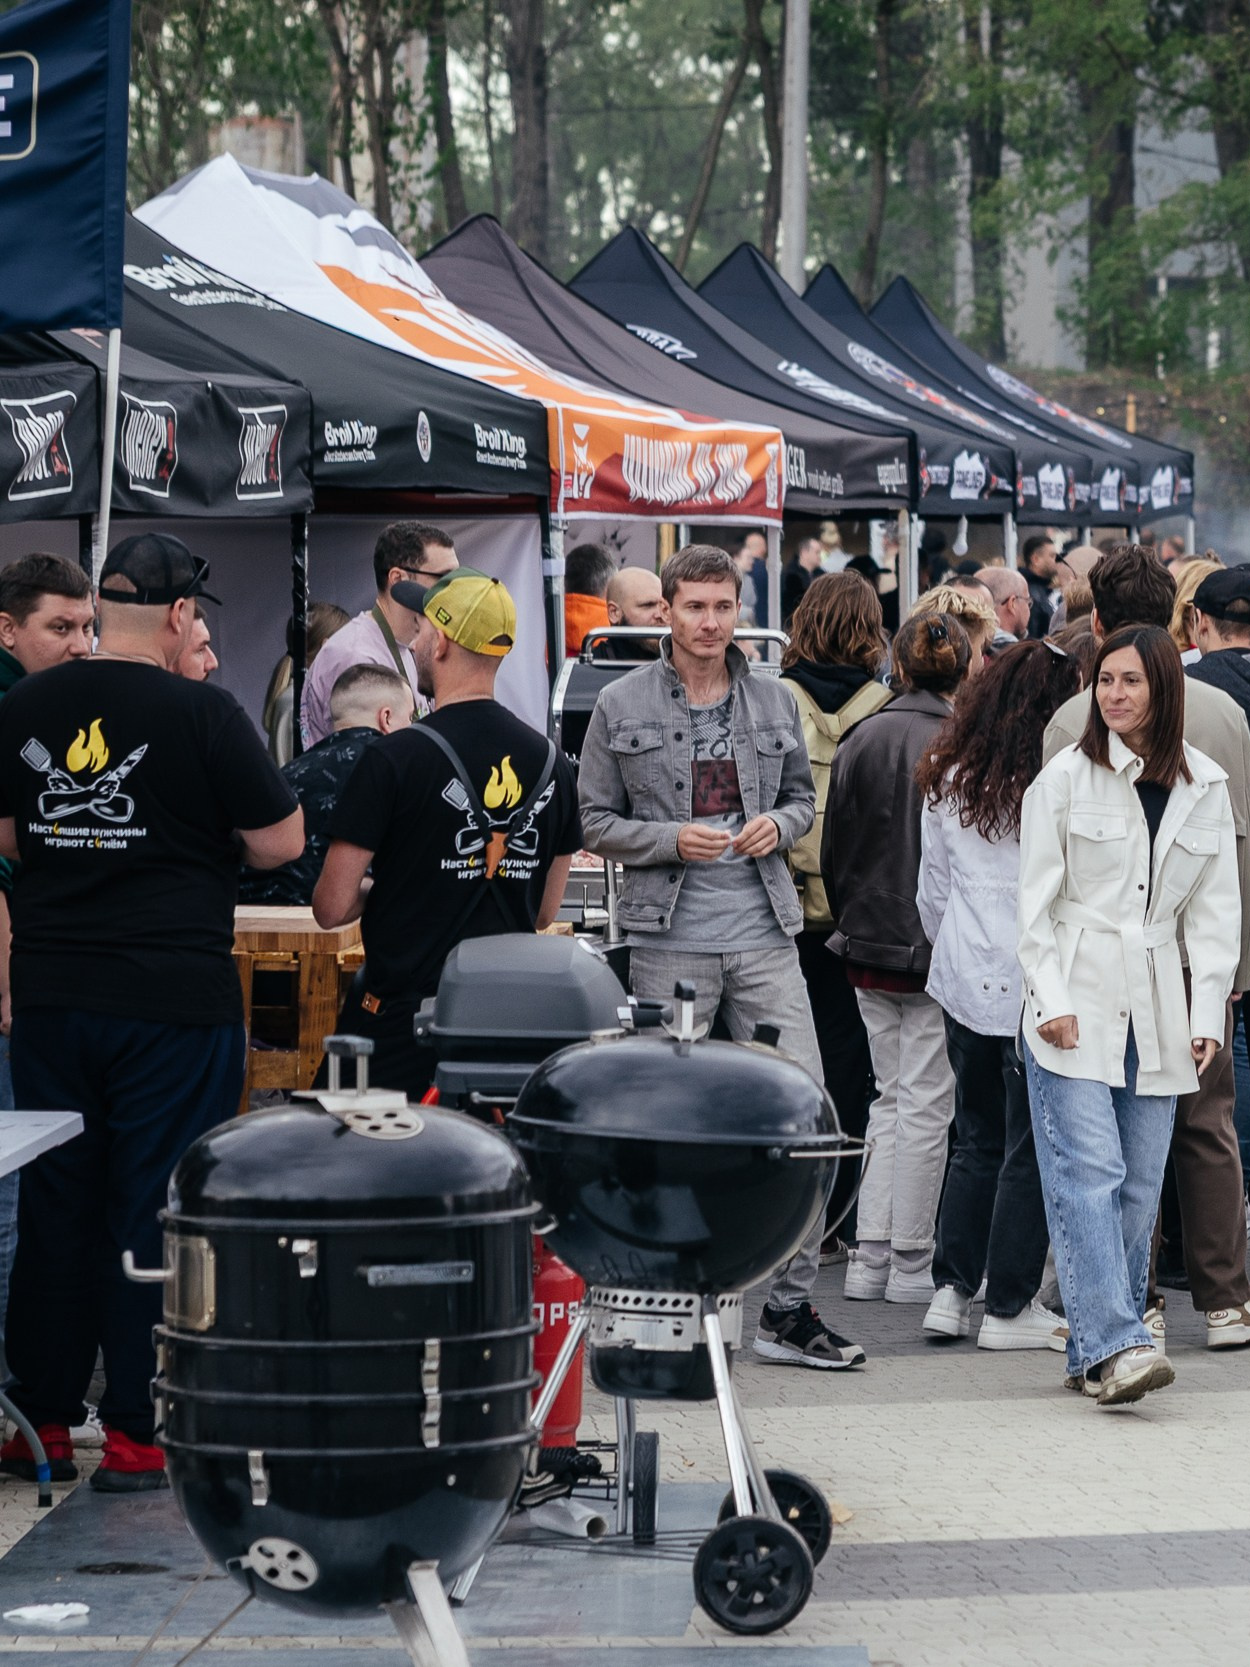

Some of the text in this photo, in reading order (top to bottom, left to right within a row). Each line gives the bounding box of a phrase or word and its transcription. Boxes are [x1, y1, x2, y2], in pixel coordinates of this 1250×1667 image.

[324, 419, 378, 449] Broil King
[474, 423, 527, 459] Broil King
